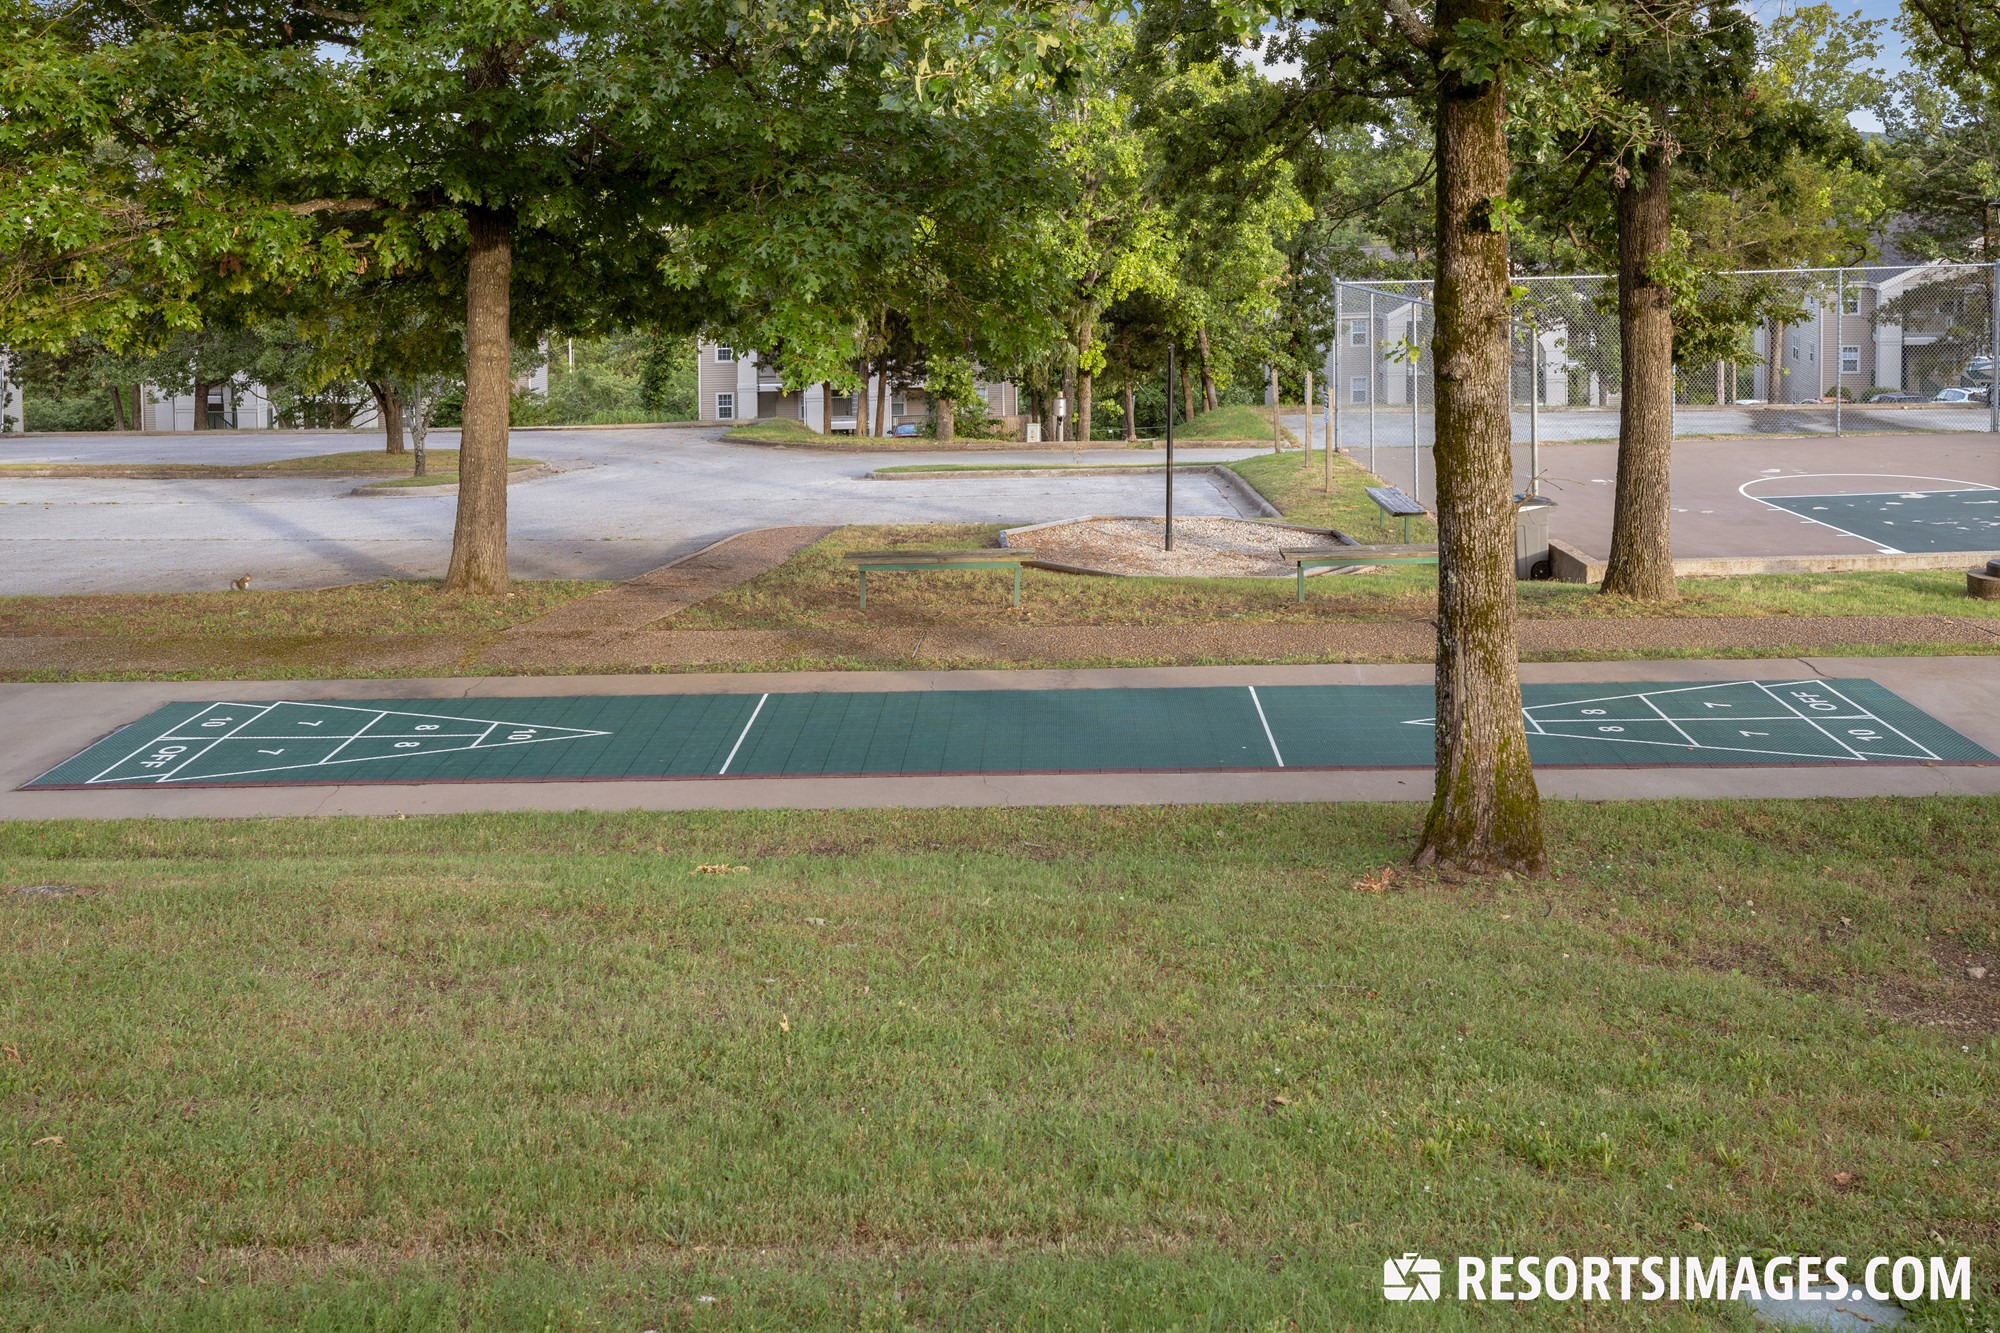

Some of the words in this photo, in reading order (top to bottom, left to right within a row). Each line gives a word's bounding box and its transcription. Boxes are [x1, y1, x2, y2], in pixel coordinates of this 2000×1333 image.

[1790, 691, 1837, 711] OFF
[201, 716, 233, 727] 10
[507, 728, 537, 741] 10
[1848, 729, 1883, 741] 10
[140, 745, 187, 768] OFF
